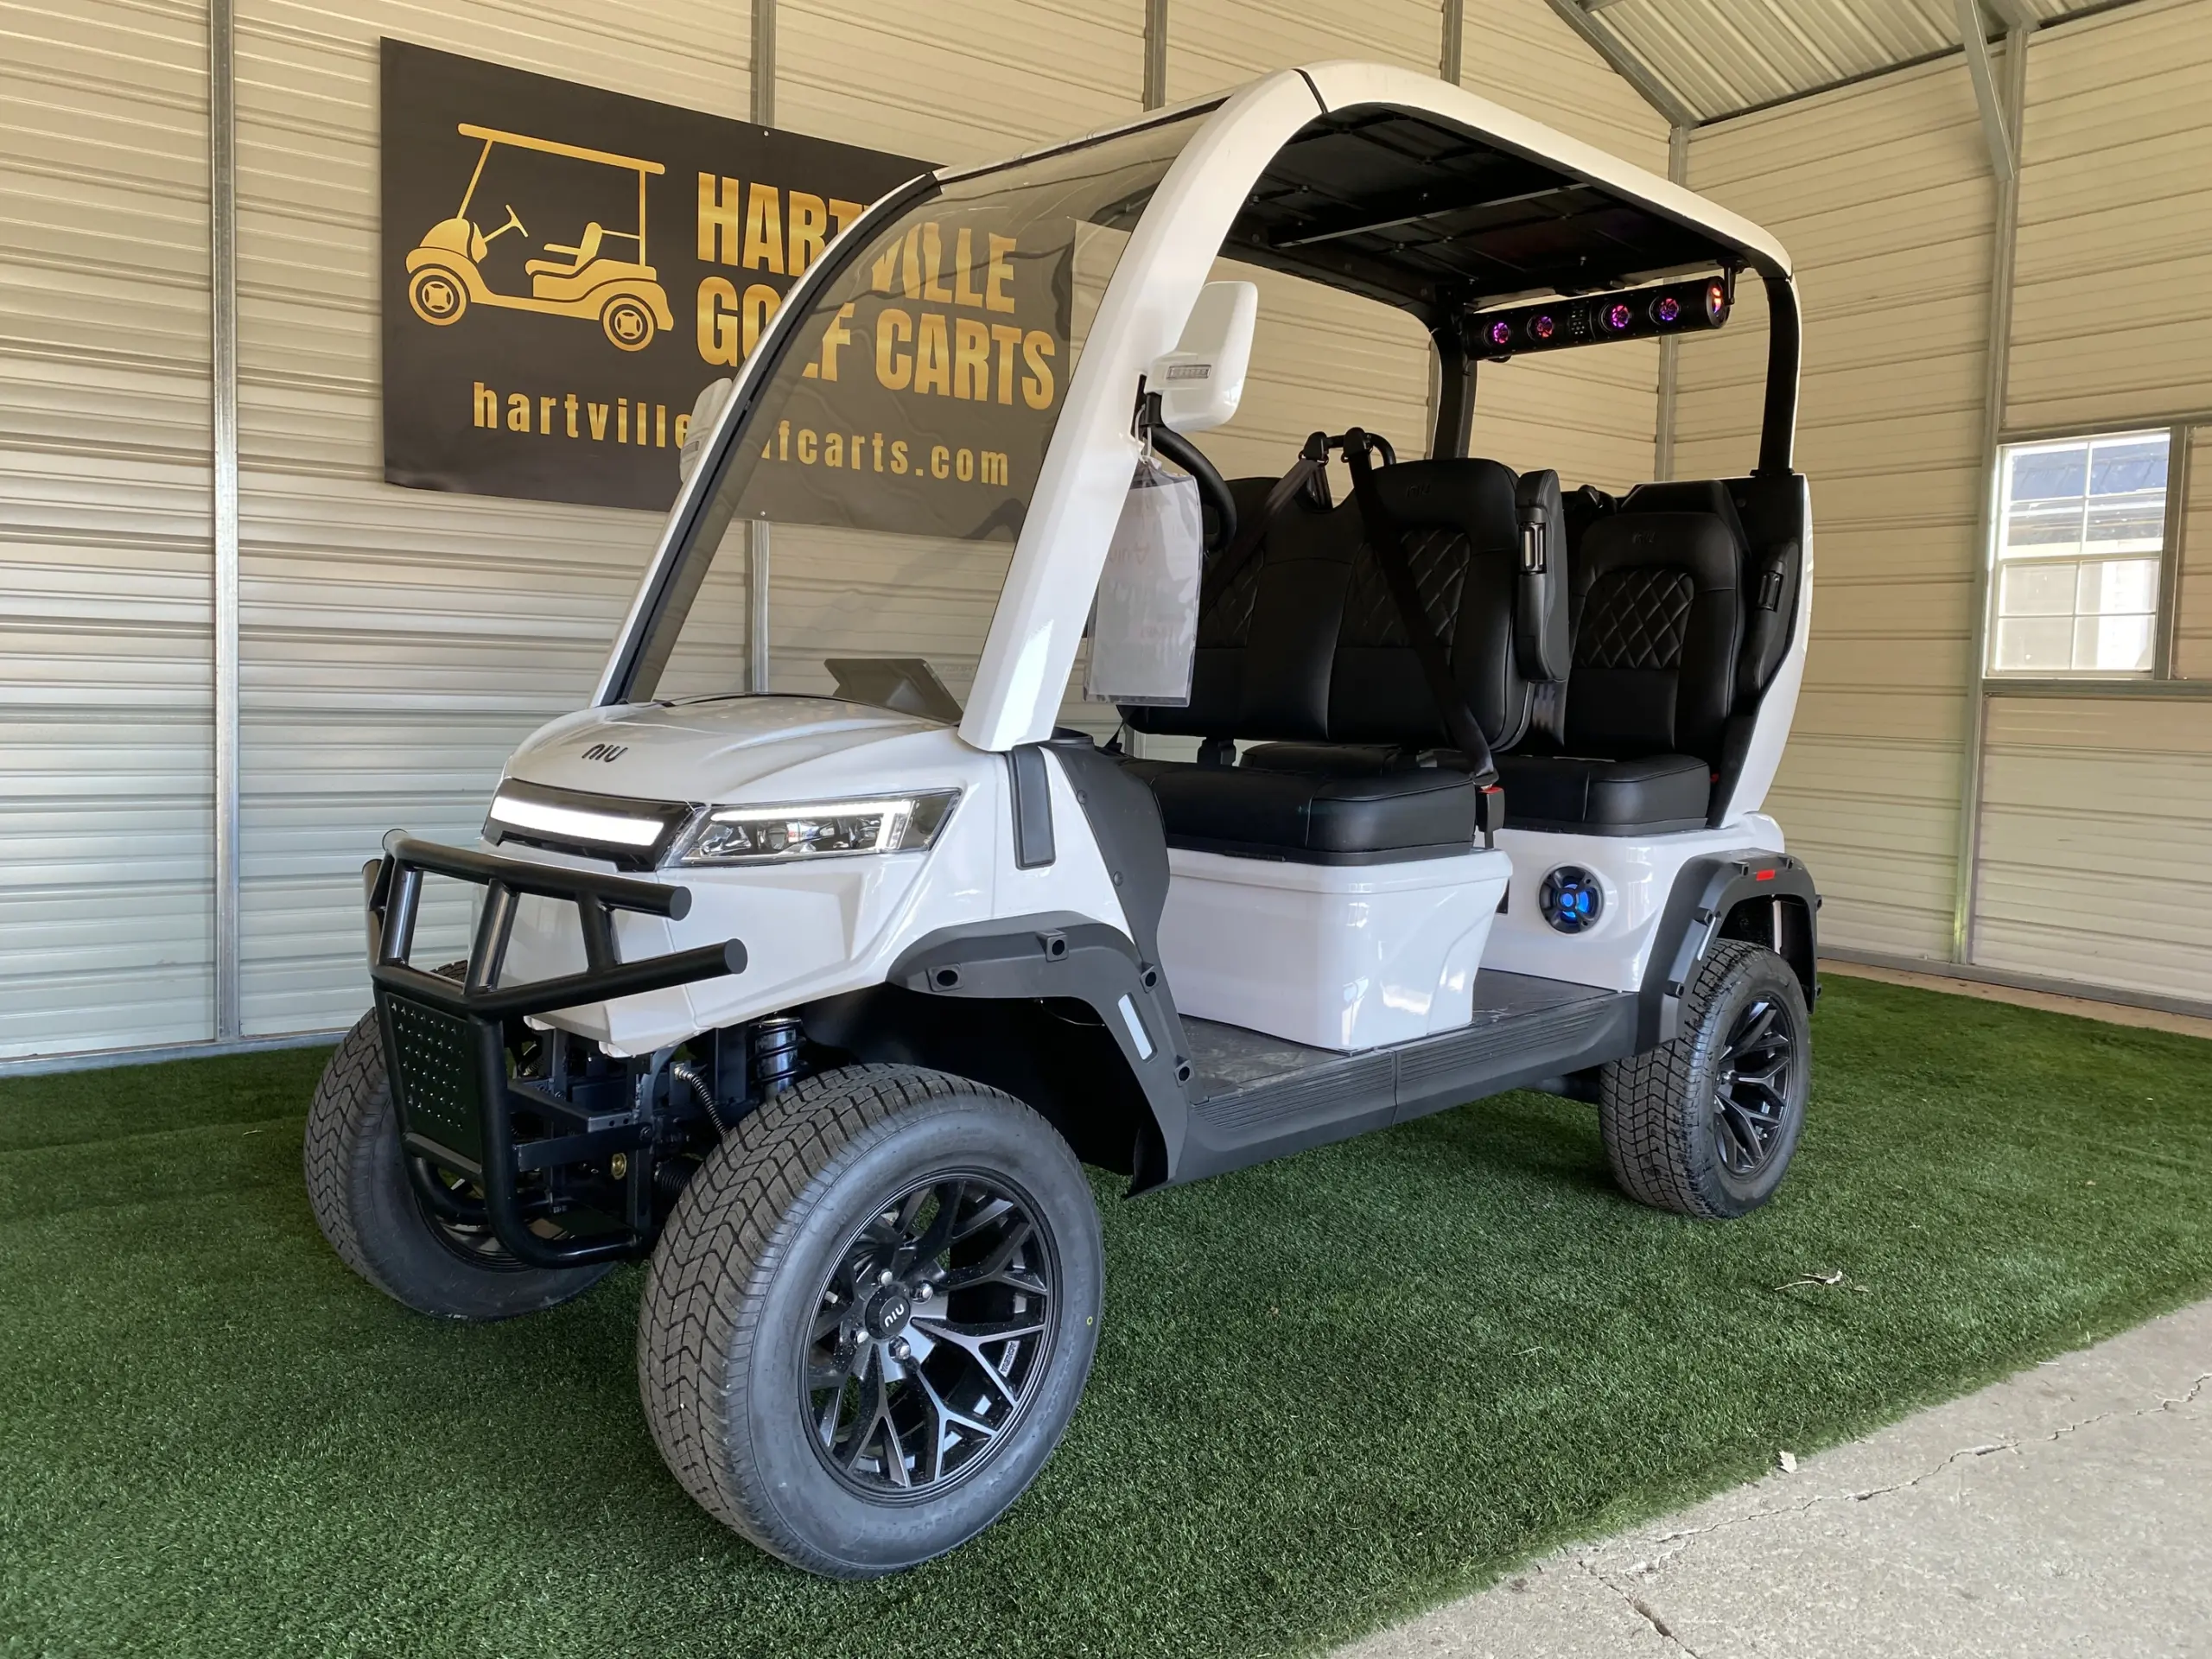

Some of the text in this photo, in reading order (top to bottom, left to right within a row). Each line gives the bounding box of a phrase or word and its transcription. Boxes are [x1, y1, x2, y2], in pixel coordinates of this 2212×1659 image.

[696, 276, 1056, 410] GOF CARTS
[473, 381, 1008, 486] hartvillefcarts.com
